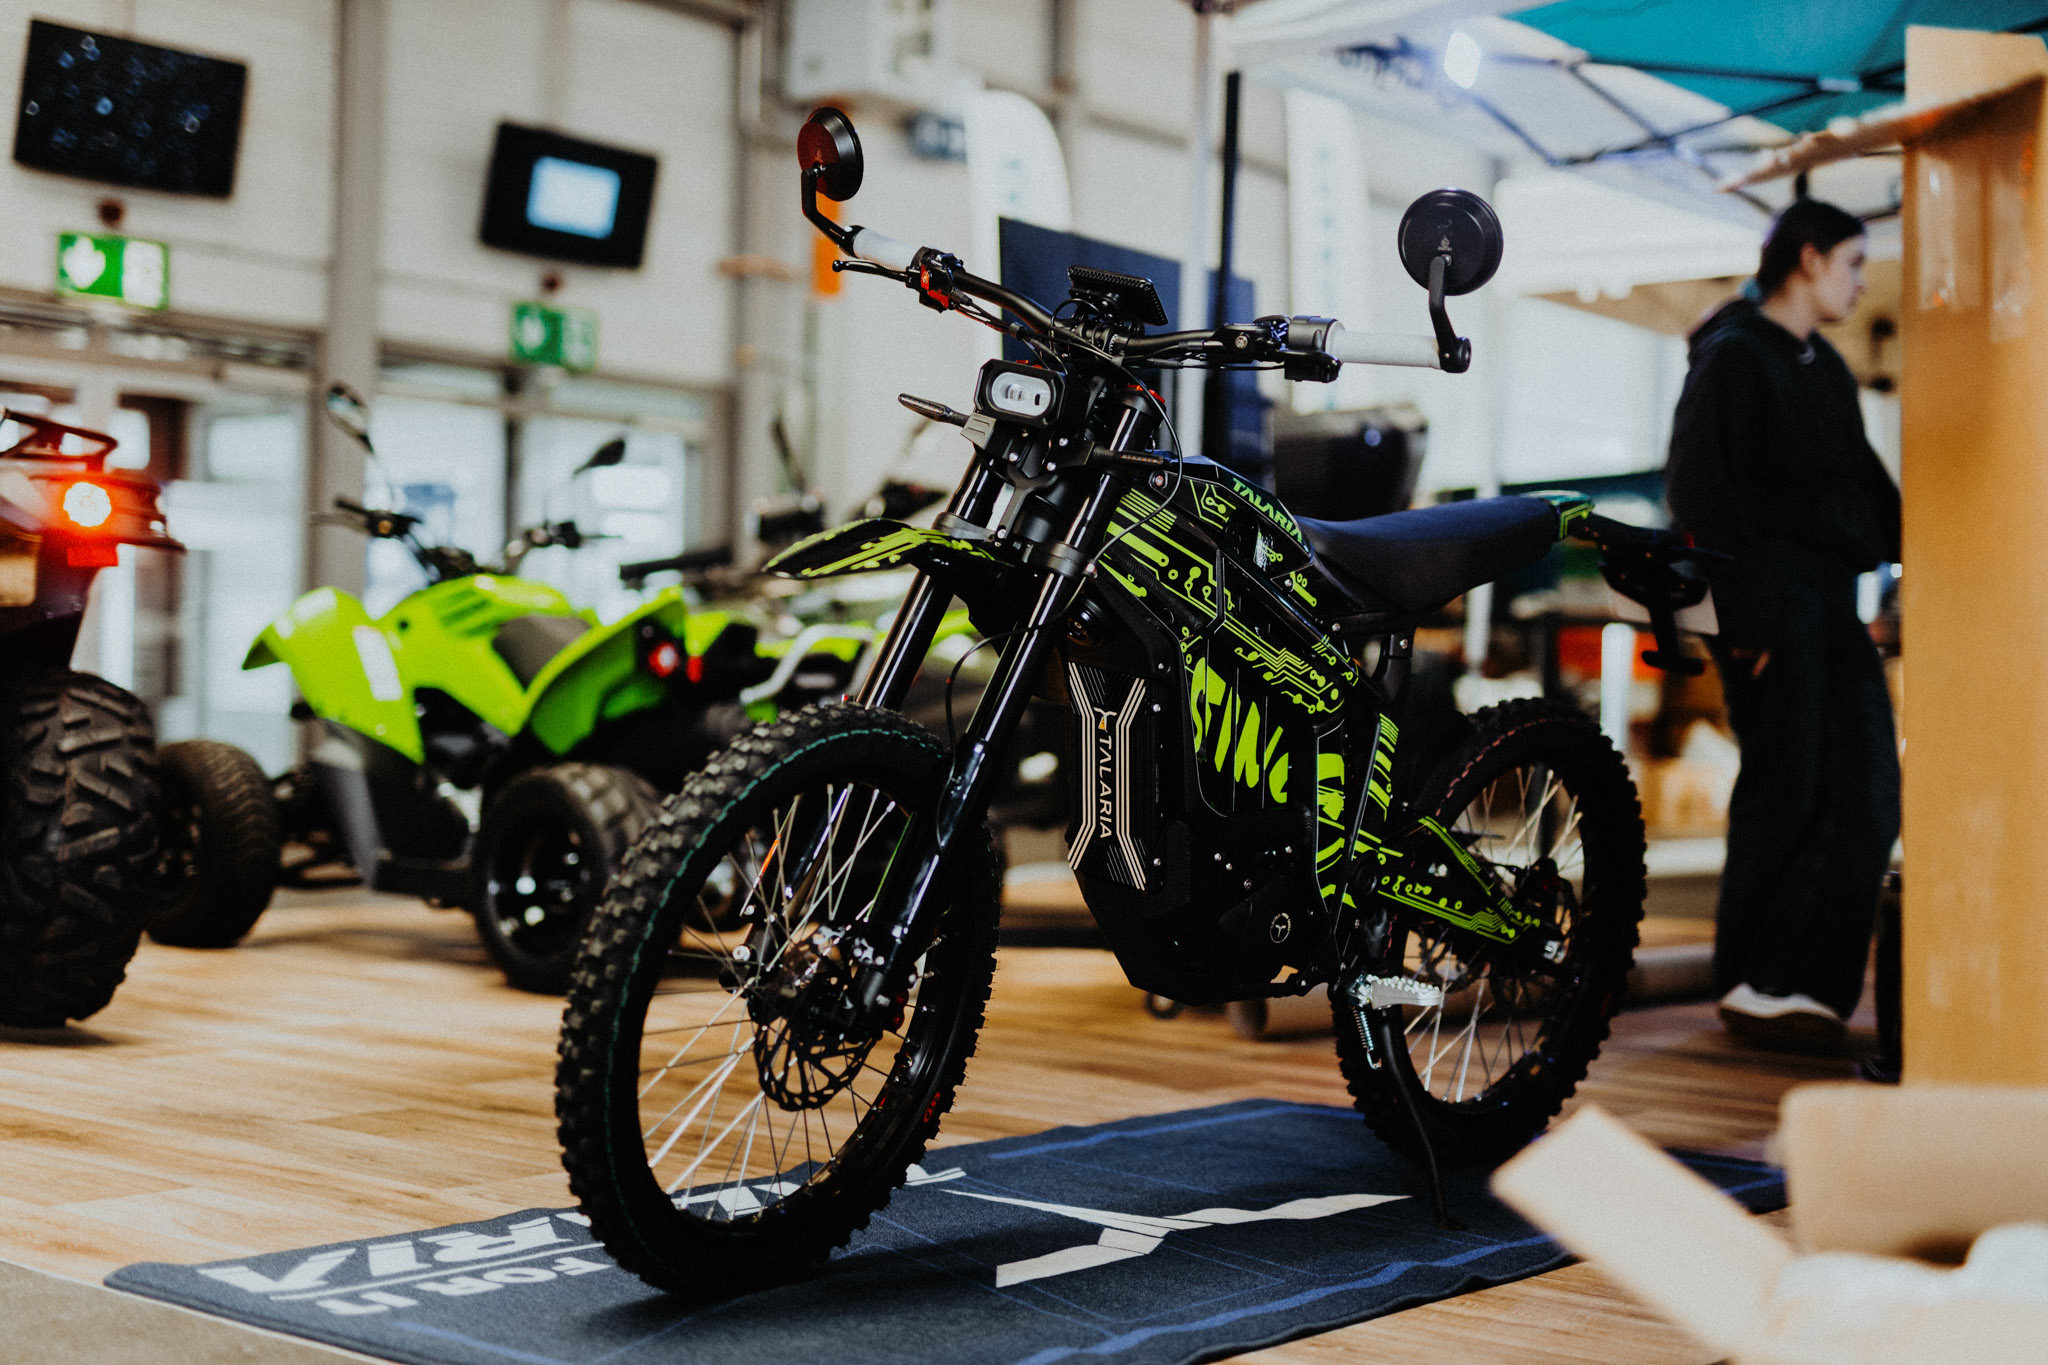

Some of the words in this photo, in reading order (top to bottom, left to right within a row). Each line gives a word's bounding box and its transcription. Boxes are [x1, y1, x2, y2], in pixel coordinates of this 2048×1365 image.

[1232, 477, 1303, 544] TALARIA
[1099, 735, 1112, 838] TALARIA
[416, 1256, 611, 1297] FOR
